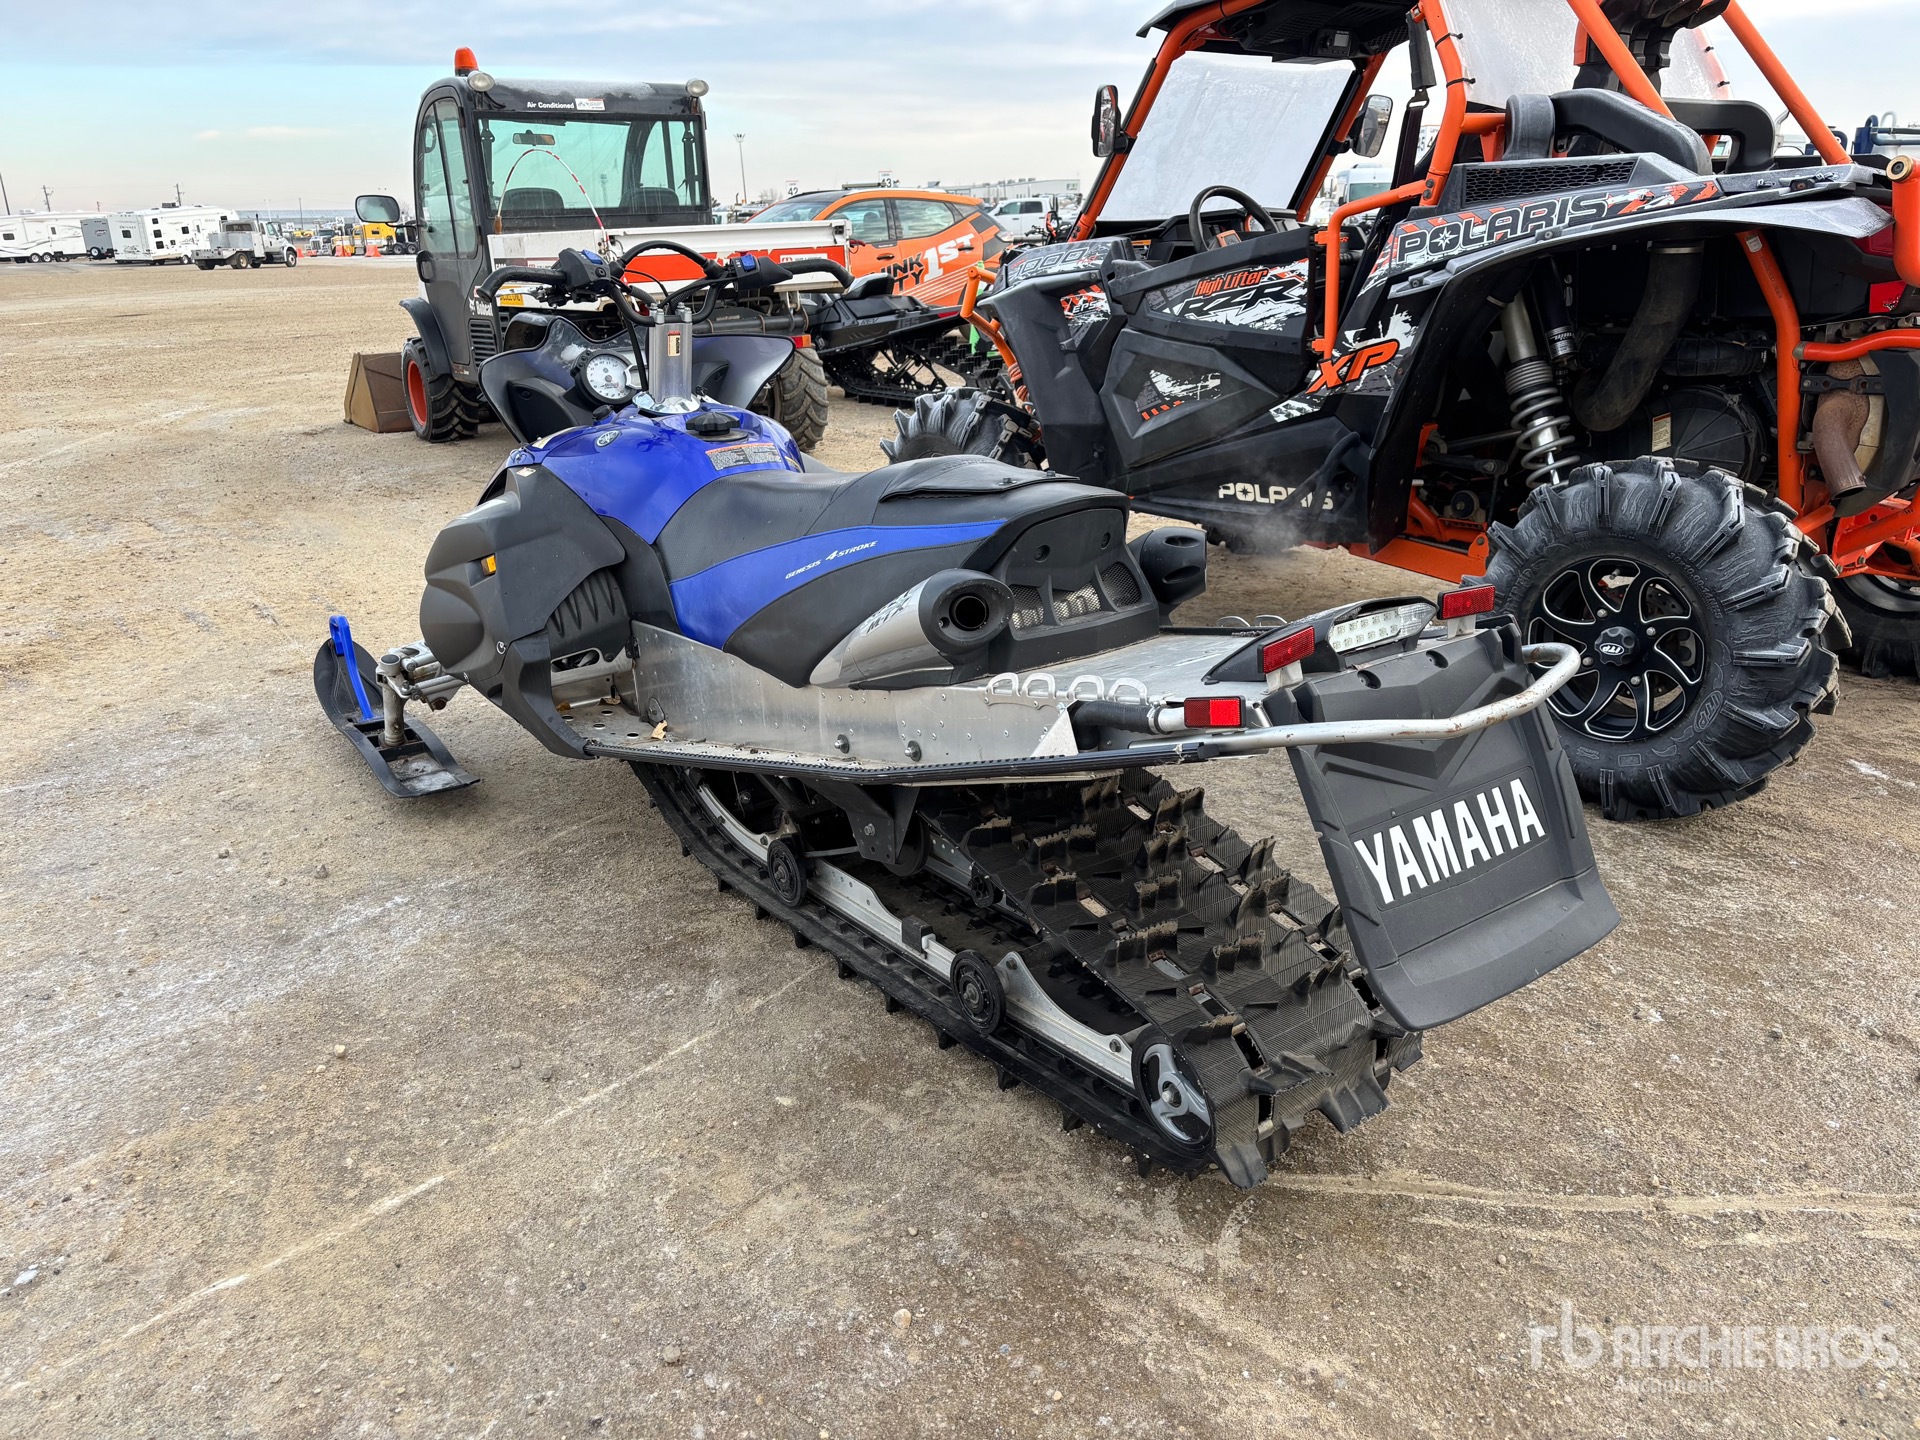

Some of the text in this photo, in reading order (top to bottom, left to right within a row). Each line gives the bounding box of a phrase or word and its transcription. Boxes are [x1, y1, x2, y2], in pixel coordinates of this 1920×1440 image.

[1397, 193, 1608, 264] POLARIS
[1176, 278, 1301, 319] RZR
[1195, 269, 1269, 296] High Lifter
[1073, 301, 1097, 314] EPS
[1305, 339, 1399, 394] XP
[785, 559, 821, 579] GENESIS
[1602, 645, 1620, 653] ITP
[1700, 692, 1721, 730] ITP
[1354, 778, 1546, 904] YAMAHA
